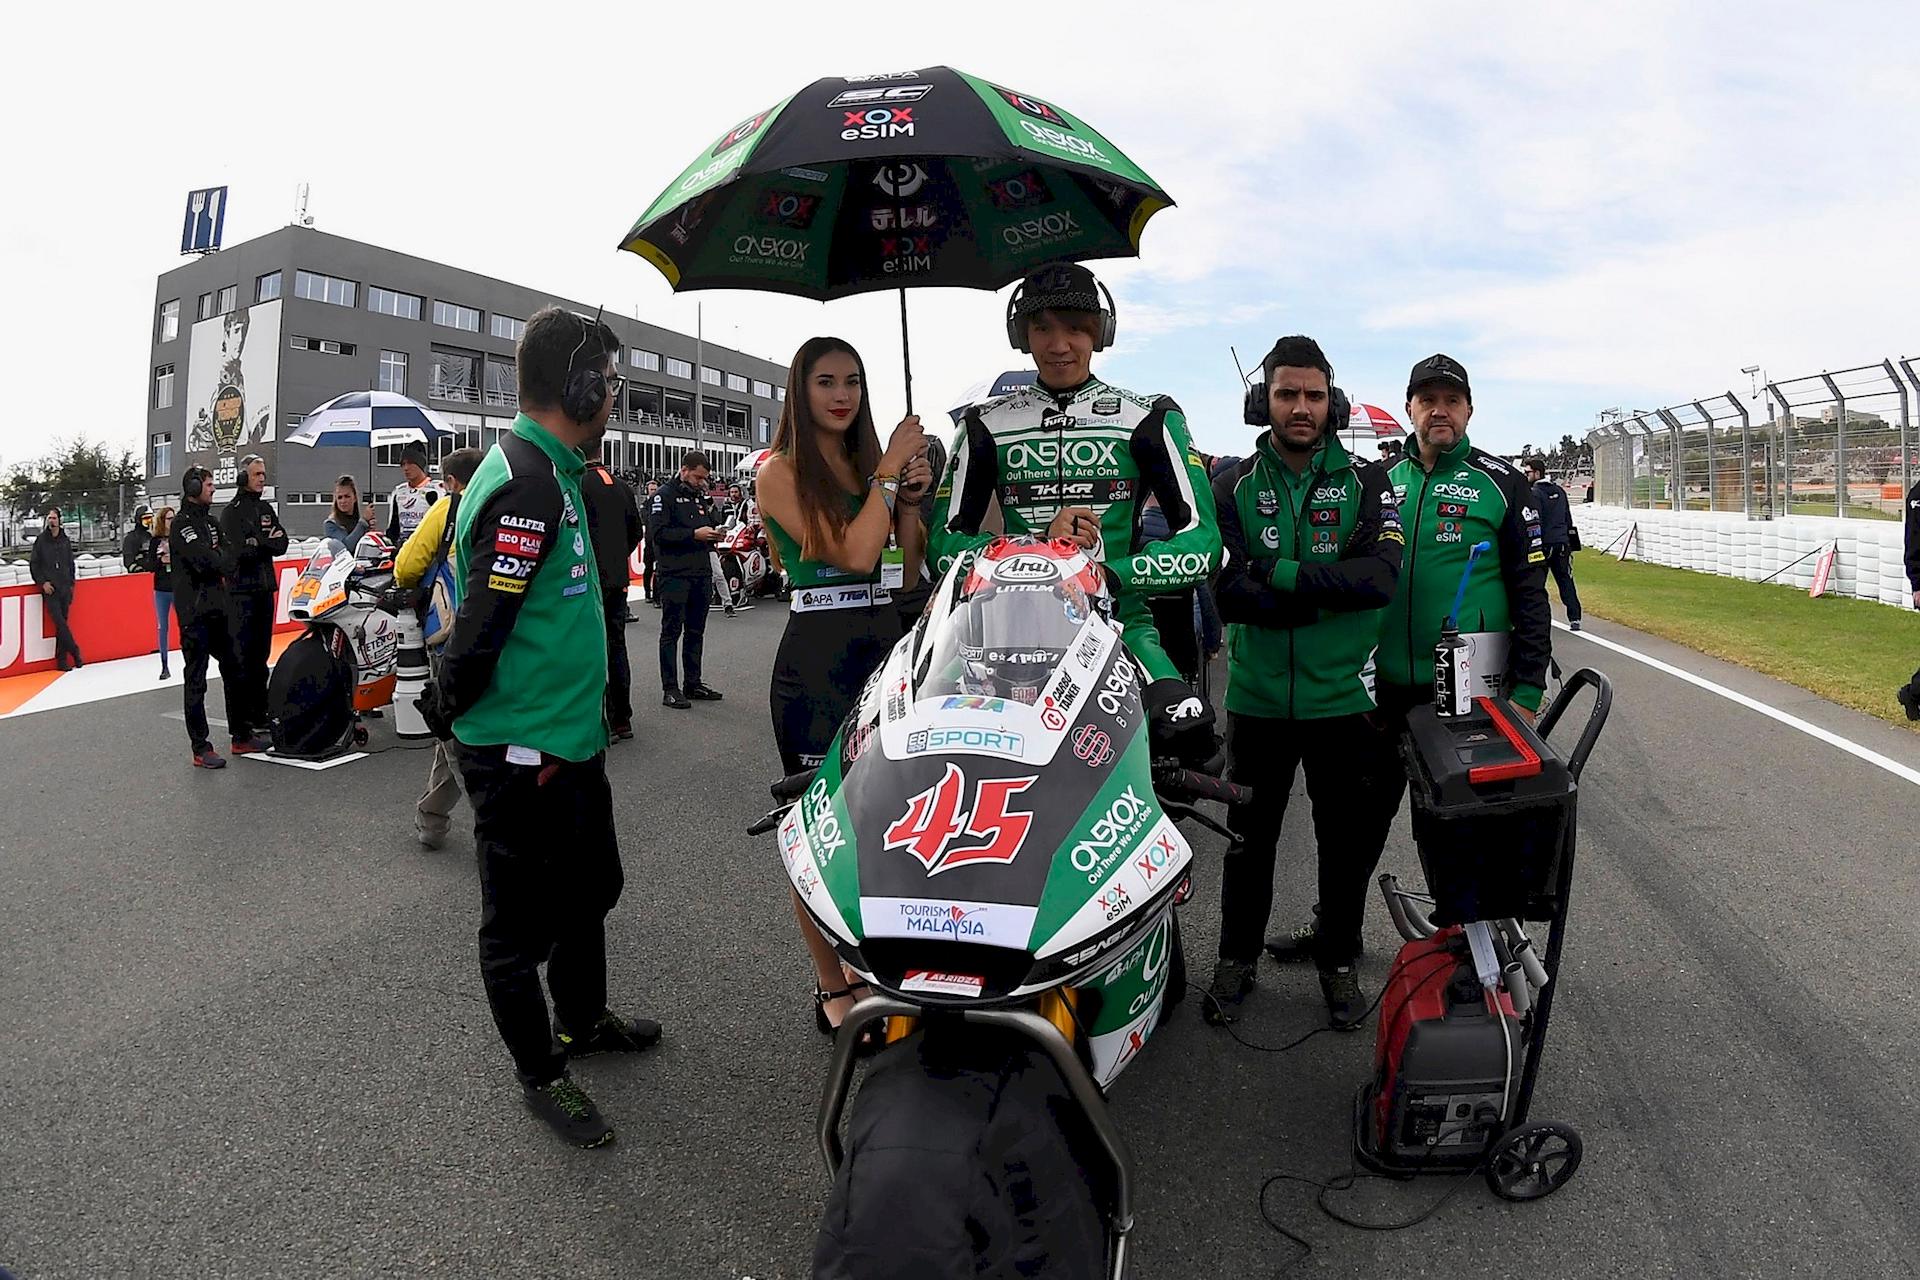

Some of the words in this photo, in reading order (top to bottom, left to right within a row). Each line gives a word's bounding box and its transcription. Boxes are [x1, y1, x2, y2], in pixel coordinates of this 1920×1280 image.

[843, 107, 913, 126] XOX
[840, 122, 915, 140] eSIM
[1003, 210, 1080, 246] ONEXOX
[733, 235, 811, 260] ONEXOX
[883, 255, 931, 273] eSIM
[220, 456, 235, 468] THE
[1006, 440, 1119, 468] ONEXOX
[1006, 471, 1021, 480] Out
[1023, 469, 1051, 480] There
[1075, 467, 1095, 477] Are
[1096, 466, 1120, 477] One
[1108, 490, 1131, 500] eSIM
[1434, 483, 1480, 499] ONEXOX
[1312, 510, 1337, 522] XOX
[1440, 503, 1466, 515] XOX
[499, 515, 546, 533] GALFER
[498, 532, 519, 544] ECO
[520, 536, 542, 549] PLAN
[1311, 542, 1339, 553] eSIM
[1436, 533, 1462, 543] eSIM
[998, 558, 1051, 575] Arai
[1131, 552, 1212, 576] ONEXOX
[1131, 576, 1145, 584] Out
[1146, 577, 1167, 585] There
[1168, 576, 1181, 584] We
[1051, 672, 1073, 703] CARBO
[1097, 651, 1137, 715] ONEXOX
[1058, 682, 1082, 712] TAINER
[929, 731, 1020, 751] SPORT
[810, 778, 847, 860] ONEXOX
[883, 762, 1040, 878] 45
[1070, 784, 1146, 872] ONEXOX
[784, 816, 801, 859] XOX
[1087, 865, 1104, 885] Out
[1100, 846, 1122, 869] There
[1118, 833, 1133, 848] We
[1129, 820, 1143, 836] Are
[1138, 806, 1153, 822] One
[1138, 834, 1176, 880] XOX
[797, 875, 813, 901] eSIM
[802, 863, 819, 891] XOX
[1097, 882, 1127, 911] XOX
[1105, 894, 1133, 922] eSIM
[900, 904, 951, 917] TOURISM
[907, 916, 985, 941] MALAYSIA
